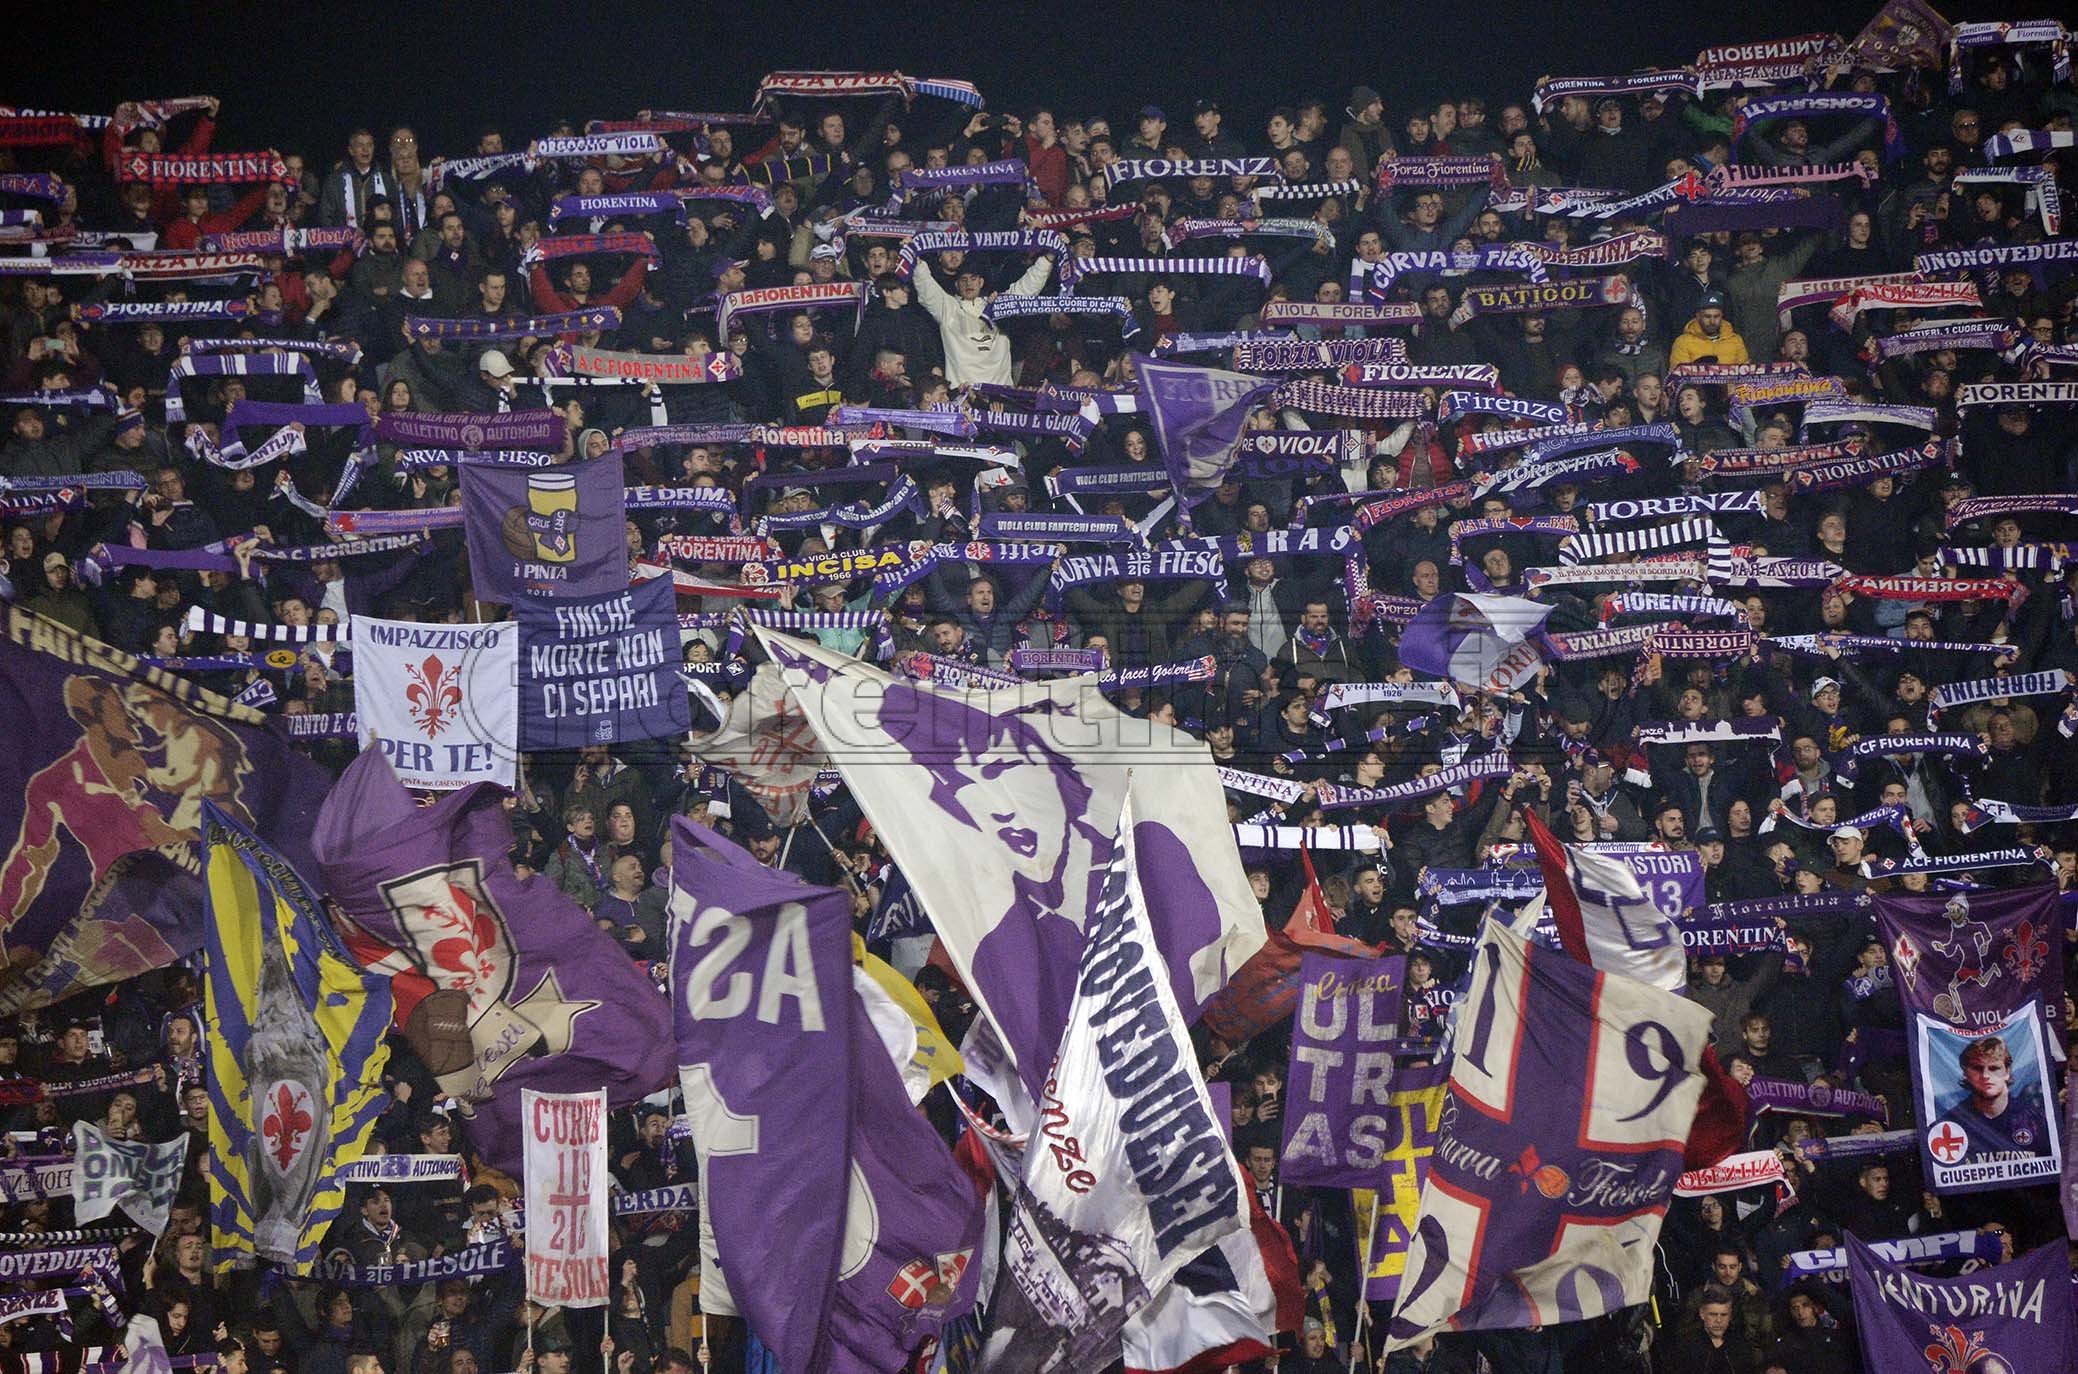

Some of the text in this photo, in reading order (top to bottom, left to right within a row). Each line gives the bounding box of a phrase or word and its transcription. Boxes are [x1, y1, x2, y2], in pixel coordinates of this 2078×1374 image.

[1549, 74, 1684, 91] FIORENTINA FIORENTINA
[537, 135, 655, 154] ORGOGLIO VIOLA
[152, 157, 268, 179] FIORENTINA
[927, 164, 1015, 178] FIORENTINA
[1114, 157, 1277, 184] FIORENZ
[1388, 161, 1490, 178] Forza Fiorentina
[580, 198, 658, 211] FIORENTINA
[912, 230, 969, 254] FIRENZE
[974, 231, 1019, 247] VANTO
[1023, 229, 1034, 245] E
[1372, 251, 1447, 289] CURVA
[1019, 299, 1038, 308] VIVE
[1041, 299, 1056, 308] NEL
[1059, 299, 1088, 308] CUORE
[1479, 285, 1594, 306] BATIGOL
[105, 300, 224, 315] FIORENTINA
[1274, 304, 1401, 320] VIOLA FOREVER
[1952, 324, 1983, 335] CUORE
[1250, 340, 1393, 368] FORZA VIOLA
[1361, 364, 1497, 386] FIORENZA
[1450, 391, 1564, 422] Firenze
[1278, 434, 1337, 455] VIOLA
[1473, 422, 1588, 448] FIORENTINA
[1754, 444, 1842, 467] FIORENTINA
[1813, 450, 1923, 482] FIORENTINA
[1597, 490, 1764, 521] IORENZA
[1024, 521, 1047, 532] CLUB
[310, 537, 421, 559] FIORENTINA
[670, 541, 762, 561] FIORENTINA
[808, 549, 866, 562] VIOLA CLUB
[523, 563, 568, 580] PINTA
[777, 551, 902, 580] INCISA
[828, 571, 852, 582] 1966
[1050, 555, 1119, 592] CURVA
[1567, 570, 1593, 578] PRIMO
[1593, 569, 1621, 577] AMORE
[1612, 592, 1736, 617] FIORENTINA
[370, 624, 499, 650] IMPAZZISCO
[1652, 635, 1748, 649] FIORENTIN
[530, 629, 665, 680] MORTE NON
[1020, 652, 1093, 666] FIORENTINA
[1119, 667, 1148, 685] facci
[542, 673, 659, 720] CI SEPARI
[1939, 672, 2056, 704] FIORENTINA
[376, 738, 493, 773] PER TE!
[1853, 736, 1971, 756] ACF FIORENTINA
[1902, 849, 2027, 868] ACF FIORENTINA
[1642, 881, 1682, 917] 13
[1681, 926, 1787, 948] ORENTINA
[1939, 1159, 2058, 1185] GIUSEPPE IACHINI
[616, 1186, 699, 1211] ERDA
[1790, 1229, 1977, 1271] CMPI
